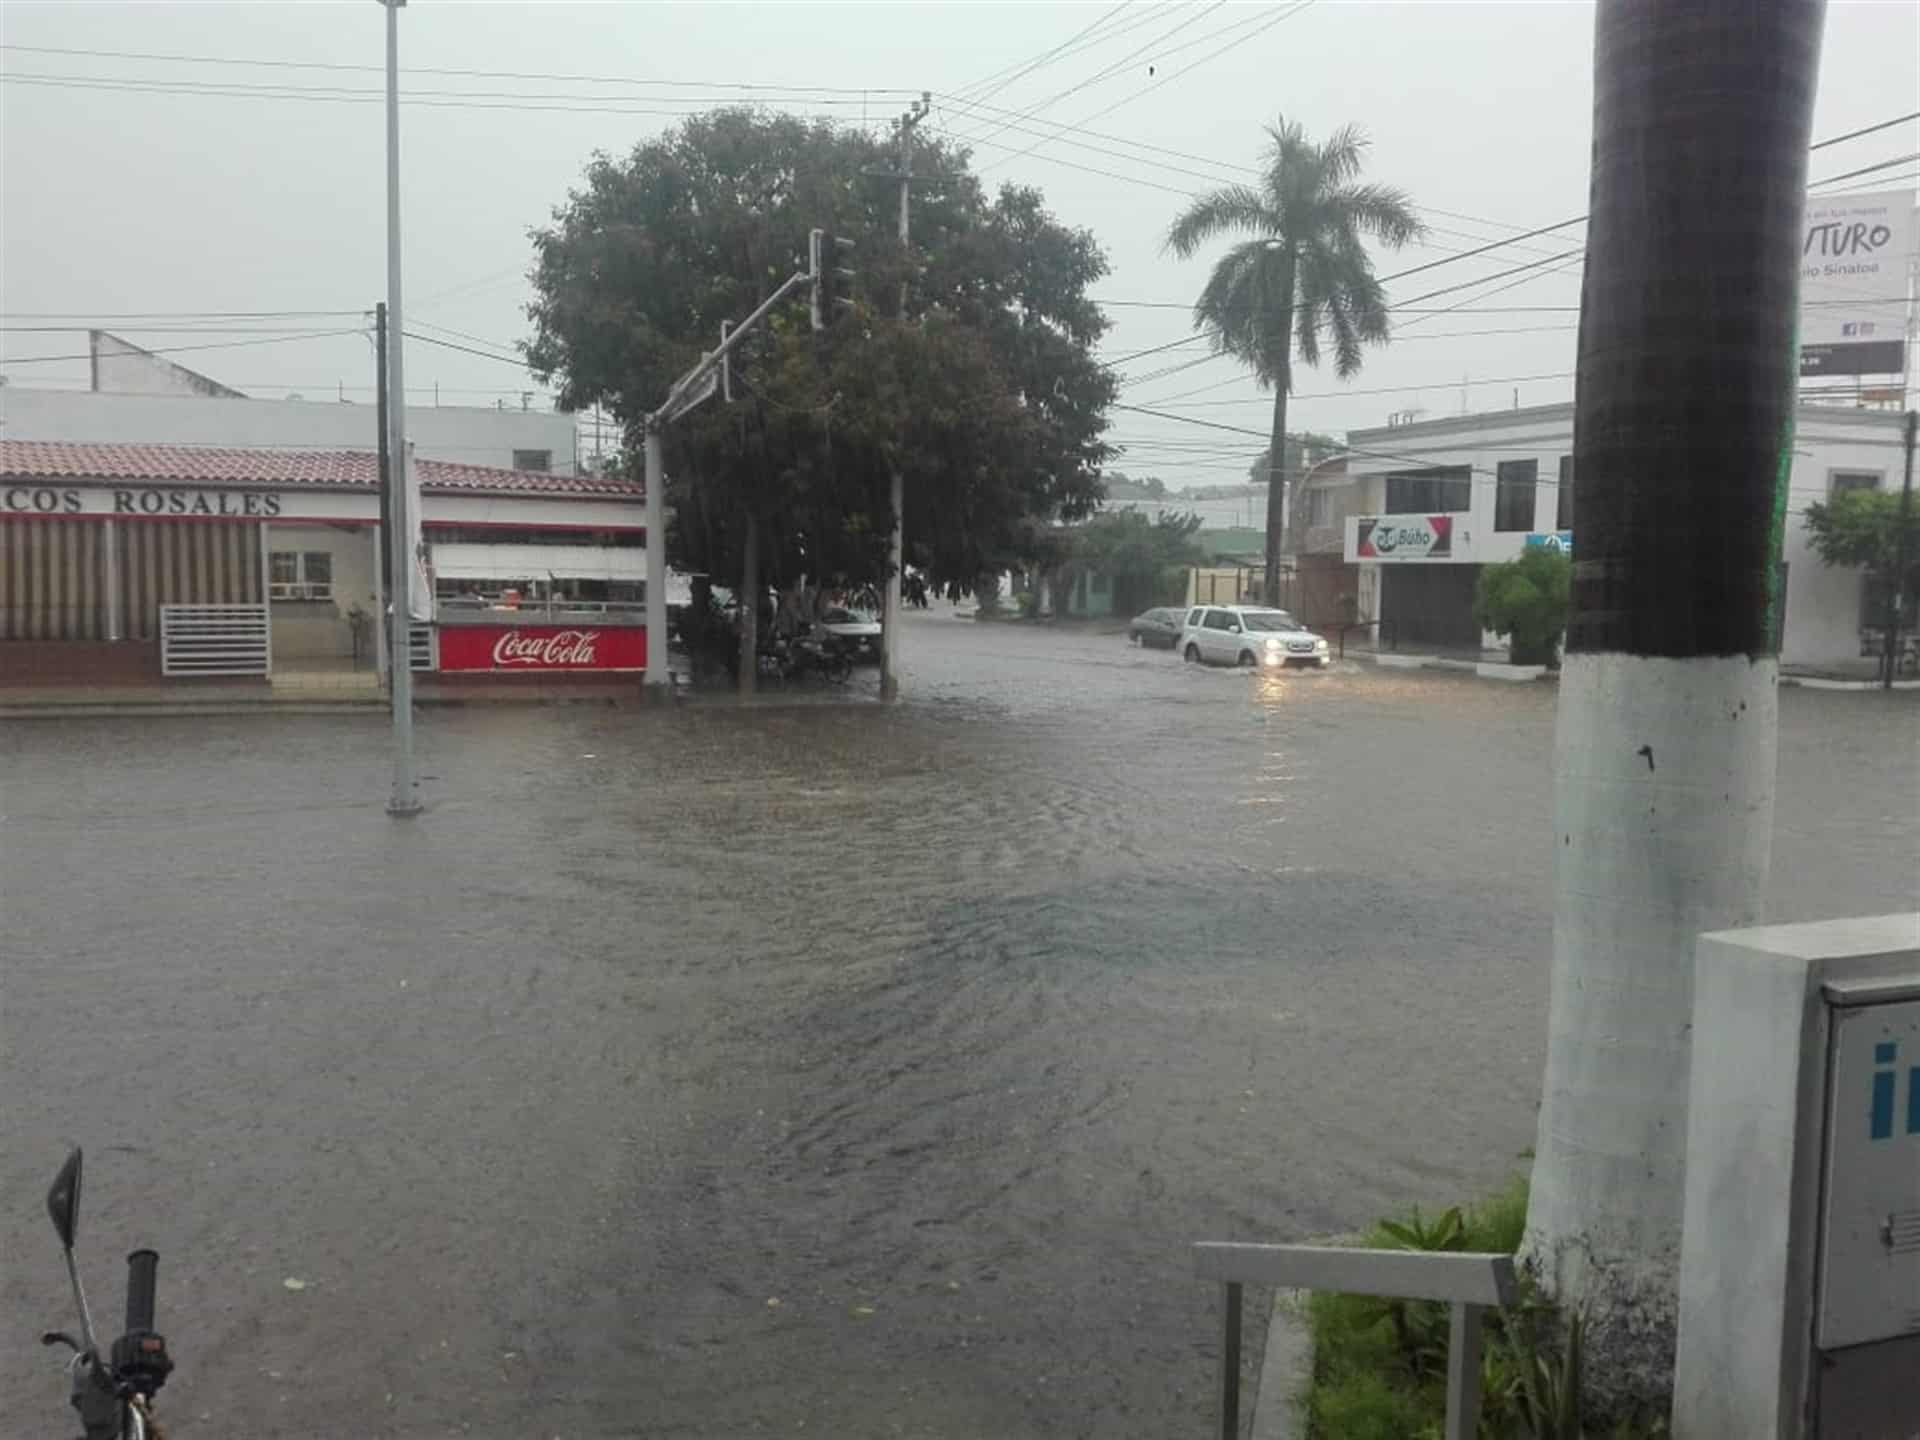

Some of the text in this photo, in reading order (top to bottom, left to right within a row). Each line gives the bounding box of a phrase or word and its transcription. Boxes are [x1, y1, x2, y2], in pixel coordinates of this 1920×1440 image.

[1823, 263, 1880, 276] Sinaloa
[0, 487, 281, 516] COS ROSALES
[492, 629, 601, 664] Coca-Cola
